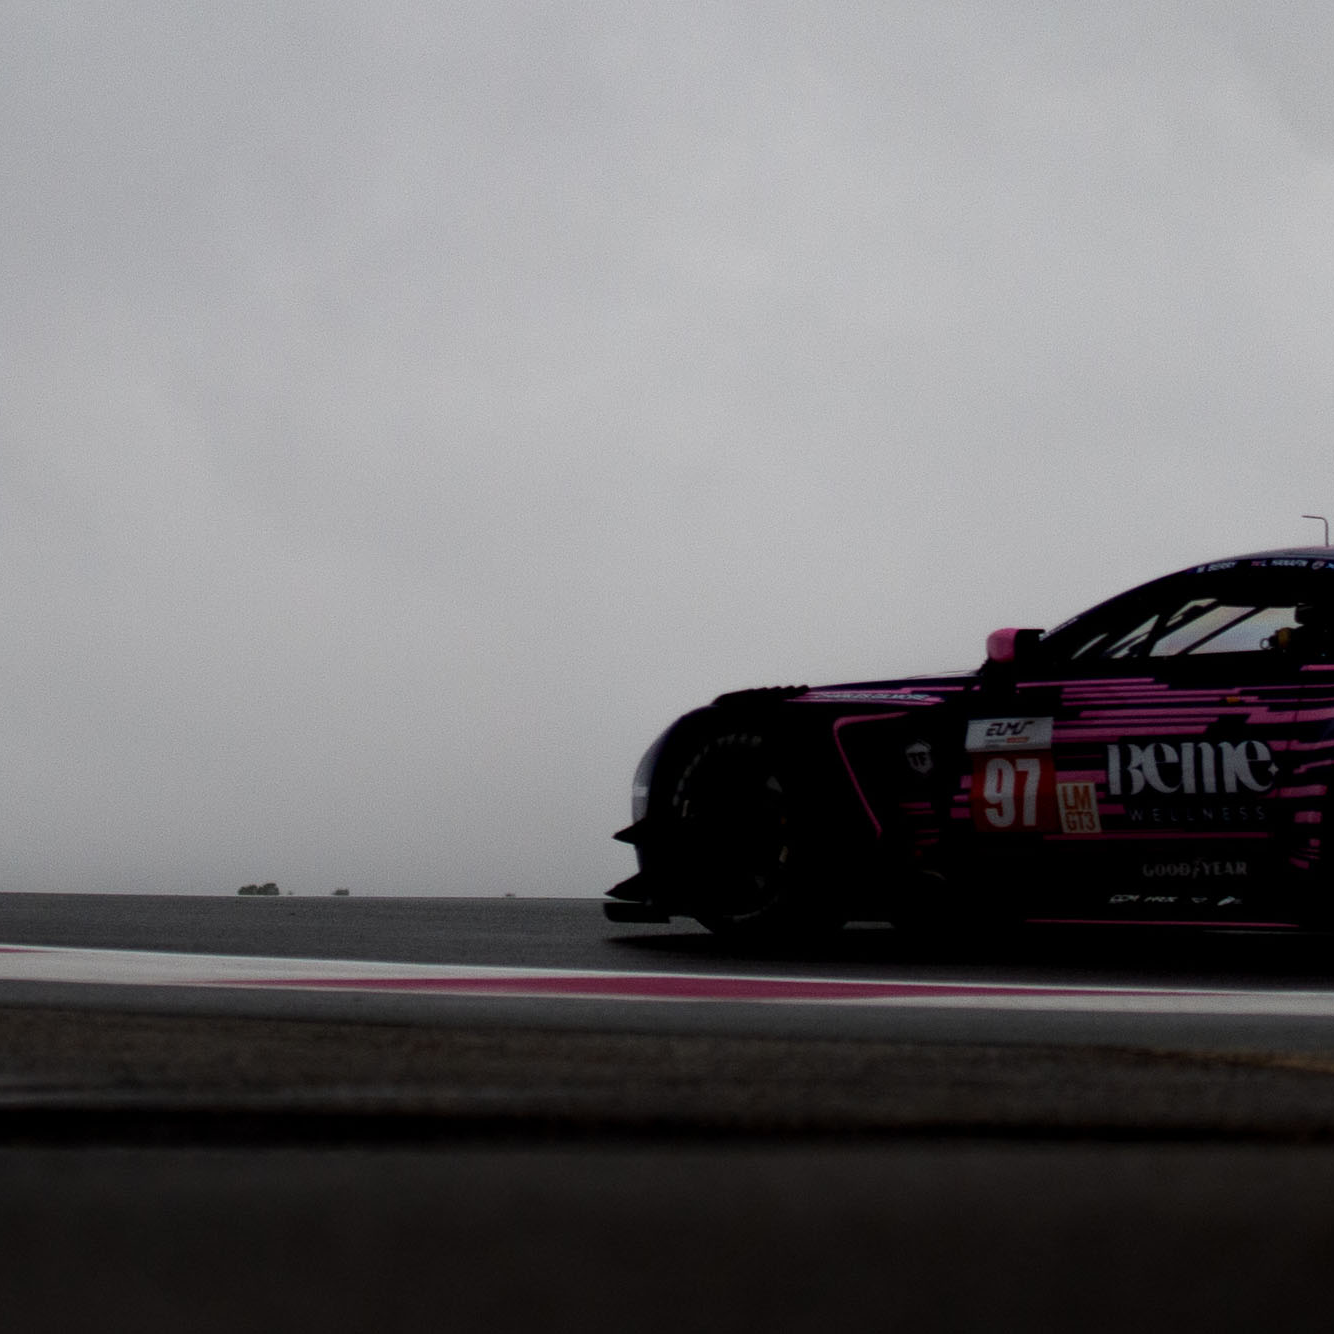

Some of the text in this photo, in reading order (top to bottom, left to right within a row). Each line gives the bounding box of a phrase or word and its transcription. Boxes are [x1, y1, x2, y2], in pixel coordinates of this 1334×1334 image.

[983, 757, 1041, 828] 97
[1062, 785, 1092, 810] LM
[1066, 811, 1096, 831] GT3
[1130, 806, 1267, 822] WELLNESS
[1143, 860, 1248, 878] GOODYEAR
